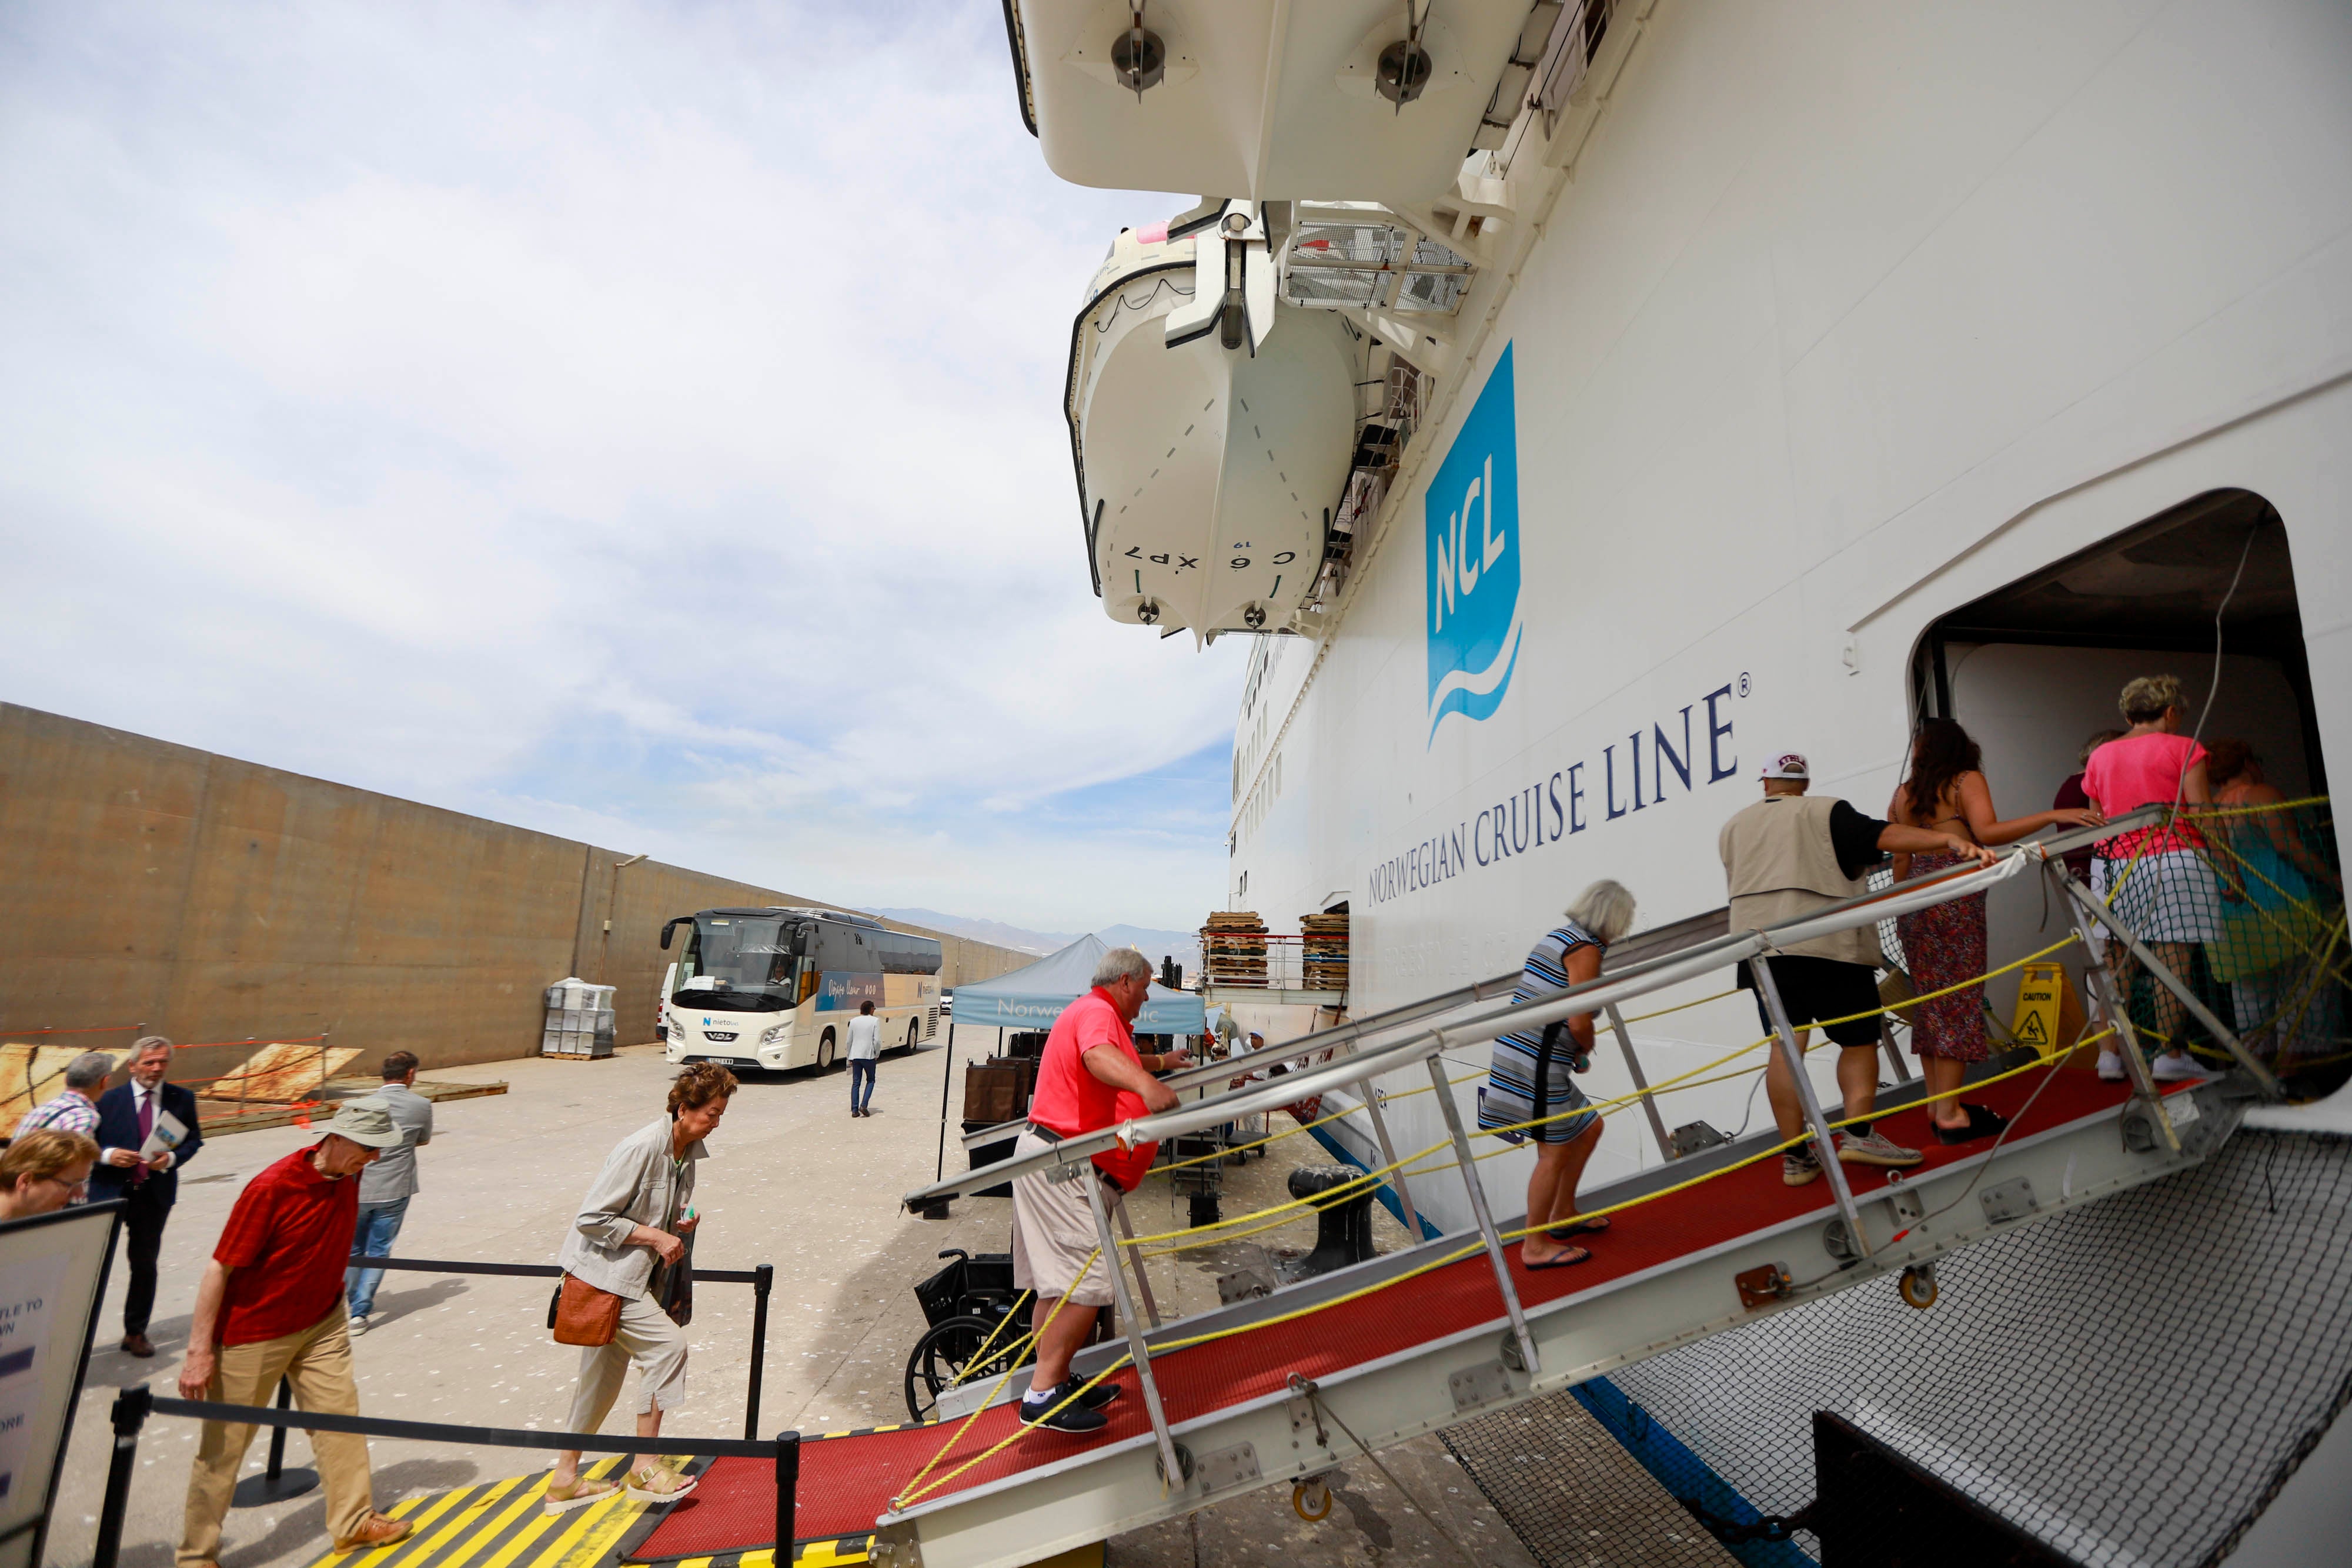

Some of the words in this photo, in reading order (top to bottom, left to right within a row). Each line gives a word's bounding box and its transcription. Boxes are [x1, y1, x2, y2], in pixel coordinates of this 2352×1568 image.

[1436, 454, 1505, 634] NCL
[1368, 822, 1466, 908] NORWEGIAN
[1475, 761, 1586, 867] CRUISE
[2023, 992, 2052, 1001] CAUTION
[707, 1032, 733, 1041] VDL
[26, 1296, 43, 1313] TO
